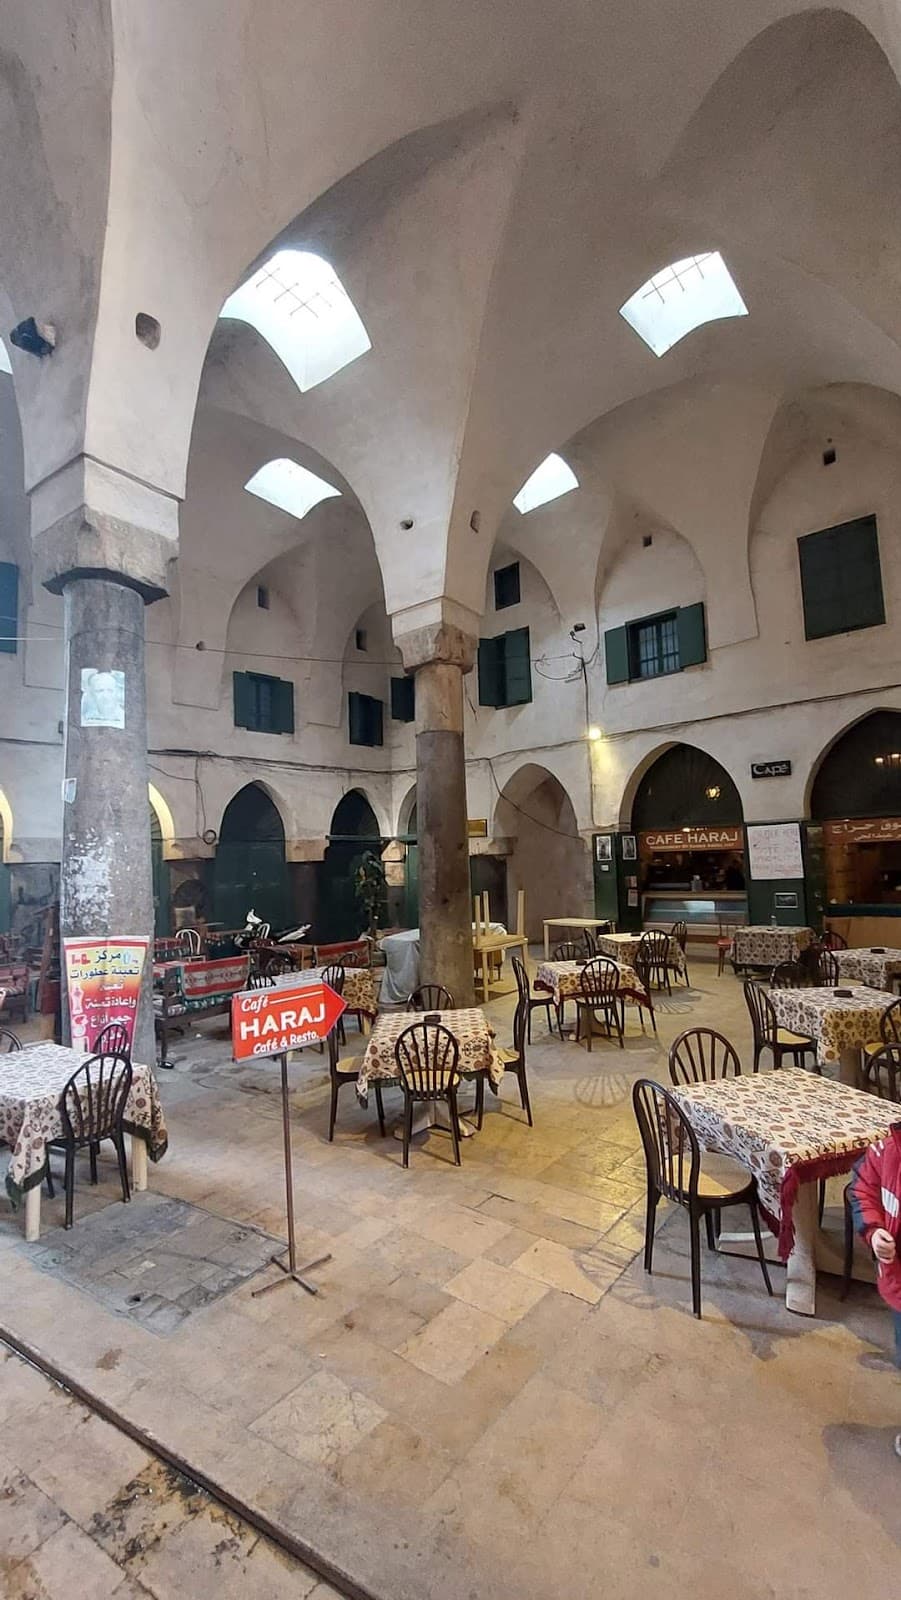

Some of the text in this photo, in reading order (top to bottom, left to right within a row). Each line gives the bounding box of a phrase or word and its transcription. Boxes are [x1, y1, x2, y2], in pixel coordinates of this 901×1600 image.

[646, 831, 738, 845] CAFE HARAJ
[95, 950, 121, 963] مركز
[240, 1003, 325, 1040] HARAJ
[253, 1038, 278, 1054] Café
[290, 1031, 319, 1044] Resto.
